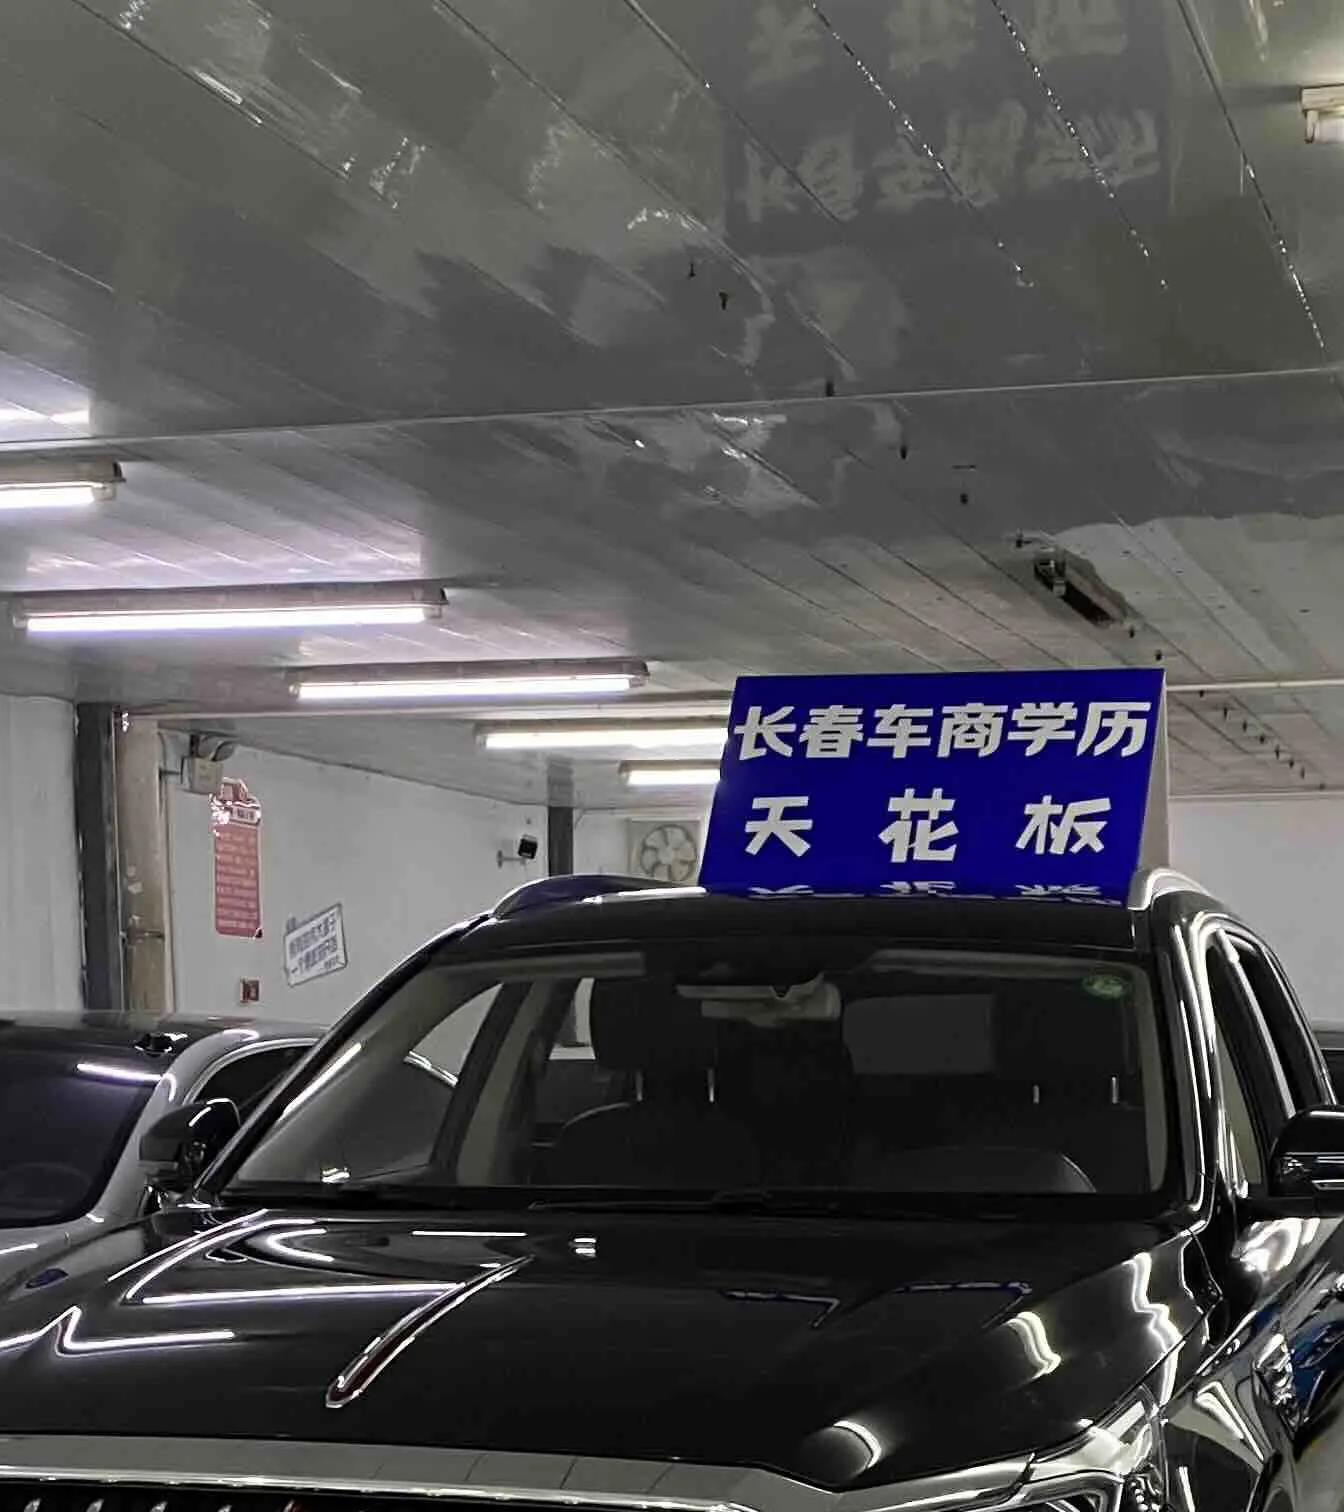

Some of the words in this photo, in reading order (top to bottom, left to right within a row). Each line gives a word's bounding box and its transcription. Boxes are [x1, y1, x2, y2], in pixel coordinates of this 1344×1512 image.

[734, 701, 1152, 761] 长春车商学历
[744, 787, 1113, 864] 天花板
